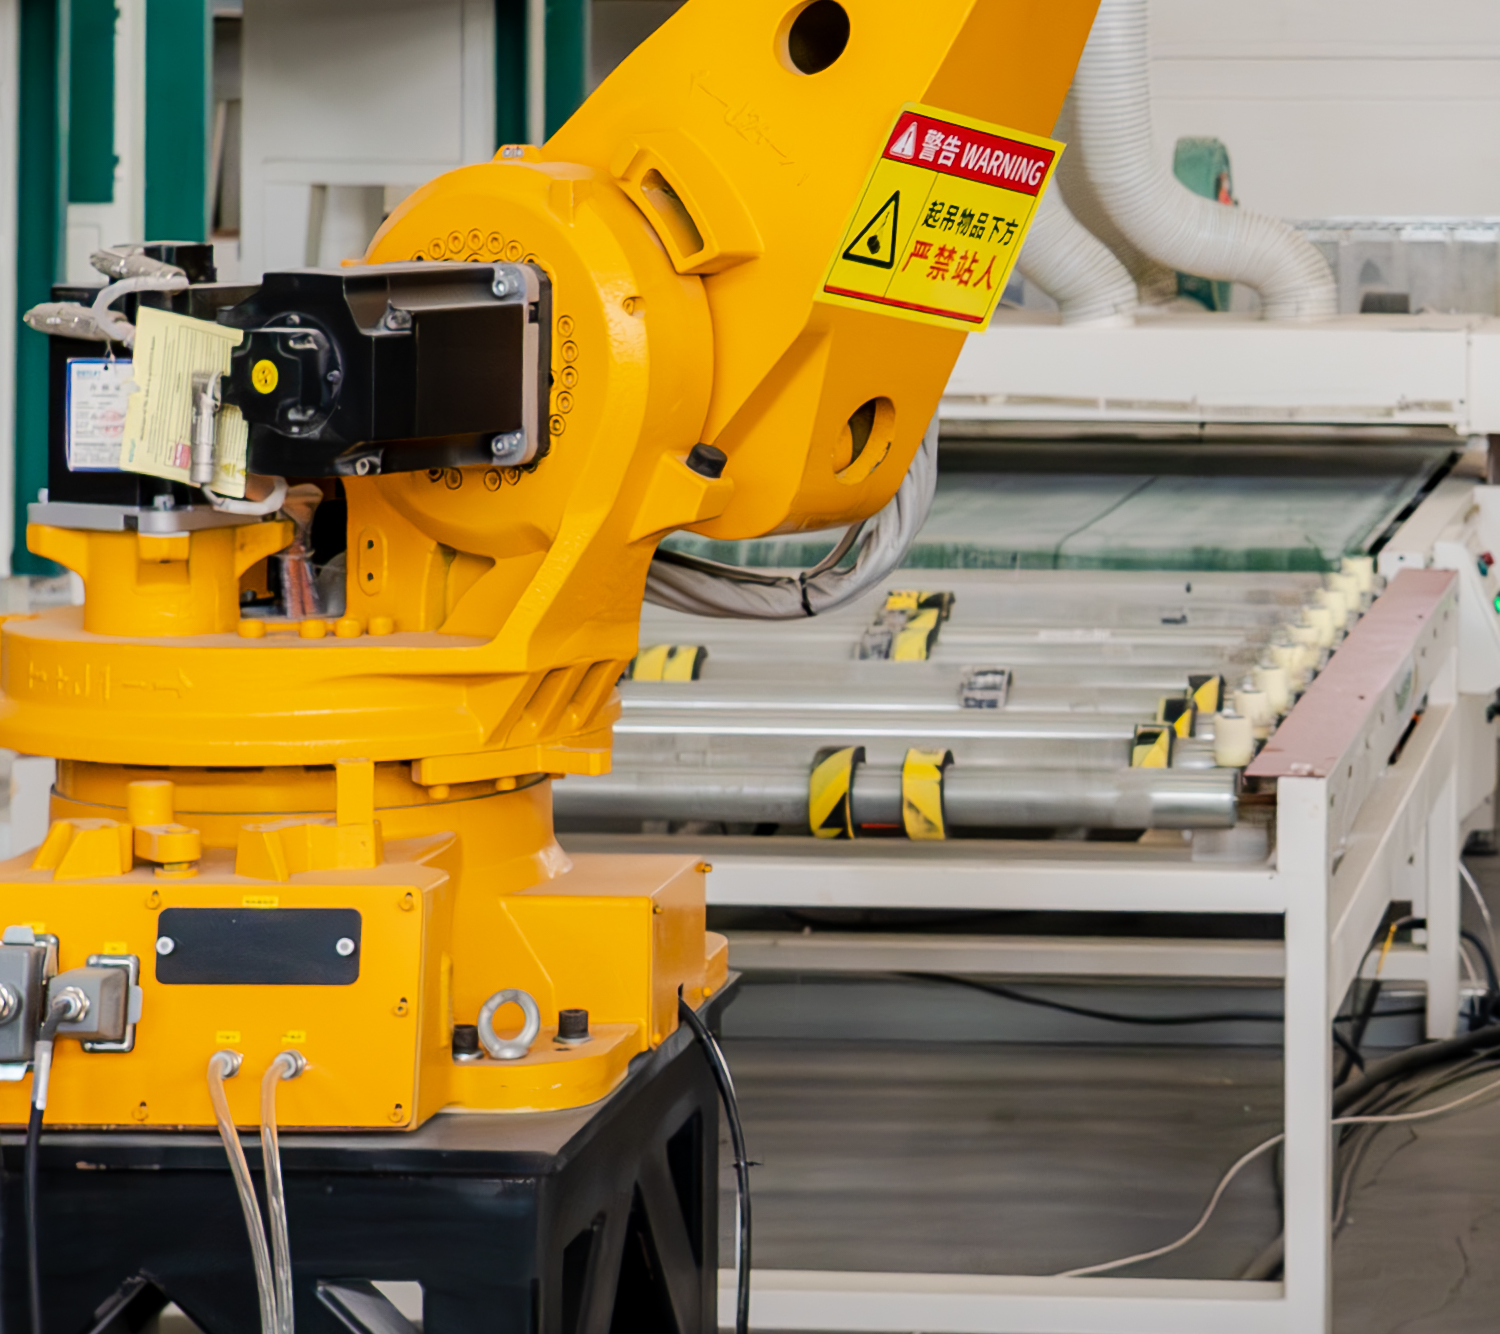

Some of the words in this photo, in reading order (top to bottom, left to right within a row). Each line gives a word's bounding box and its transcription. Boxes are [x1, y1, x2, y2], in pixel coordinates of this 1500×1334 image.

[918, 129, 961, 167] 警告
[961, 142, 1045, 186] WARNING
[921, 200, 1020, 246] 起吊物品下方
[901, 240, 998, 291] 严禁站人
